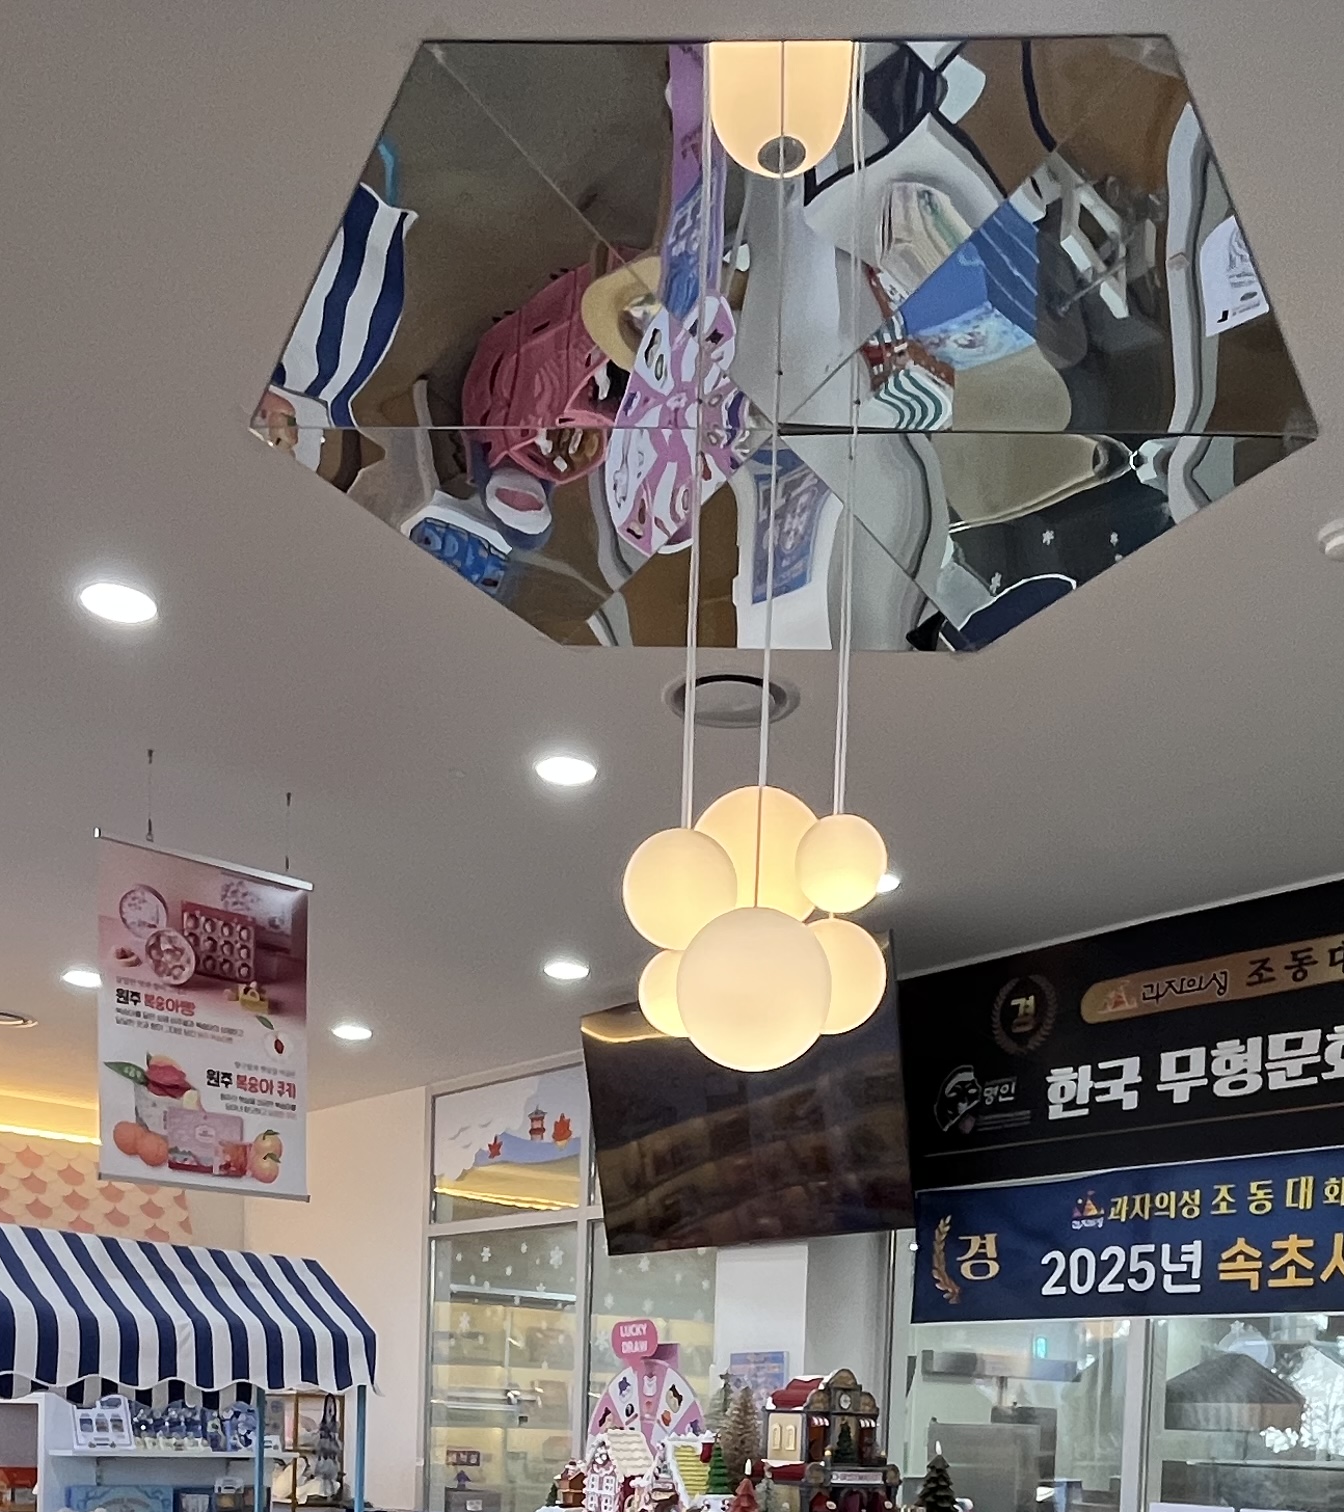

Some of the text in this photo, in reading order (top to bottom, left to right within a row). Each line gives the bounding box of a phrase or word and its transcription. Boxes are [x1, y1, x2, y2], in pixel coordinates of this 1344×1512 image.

[1141, 968, 1229, 1003] 과자의성
[1246, 958, 1276, 987] 조
[1285, 946, 1318, 982] 동
[116, 988, 196, 1017] 원주 복숭아빵
[1010, 994, 1037, 1033] 경
[206, 1068, 234, 1089] 원주
[236, 1074, 275, 1096] 복숭아
[276, 1080, 296, 1100] 쿠키
[983, 1081, 1016, 1105] 명인
[1045, 1057, 1143, 1120] 한국
[1107, 1188, 1202, 1223] 과자의성
[1211, 1184, 1237, 1216] 조
[1248, 1180, 1275, 1214] 동
[1286, 1175, 1314, 1211] 대
[957, 1232, 1000, 1283] 경
[1039, 1238, 1204, 1298] 2025년
[619, 1323, 647, 1338] LUCKY
[621, 1340, 648, 1354] DRAW
